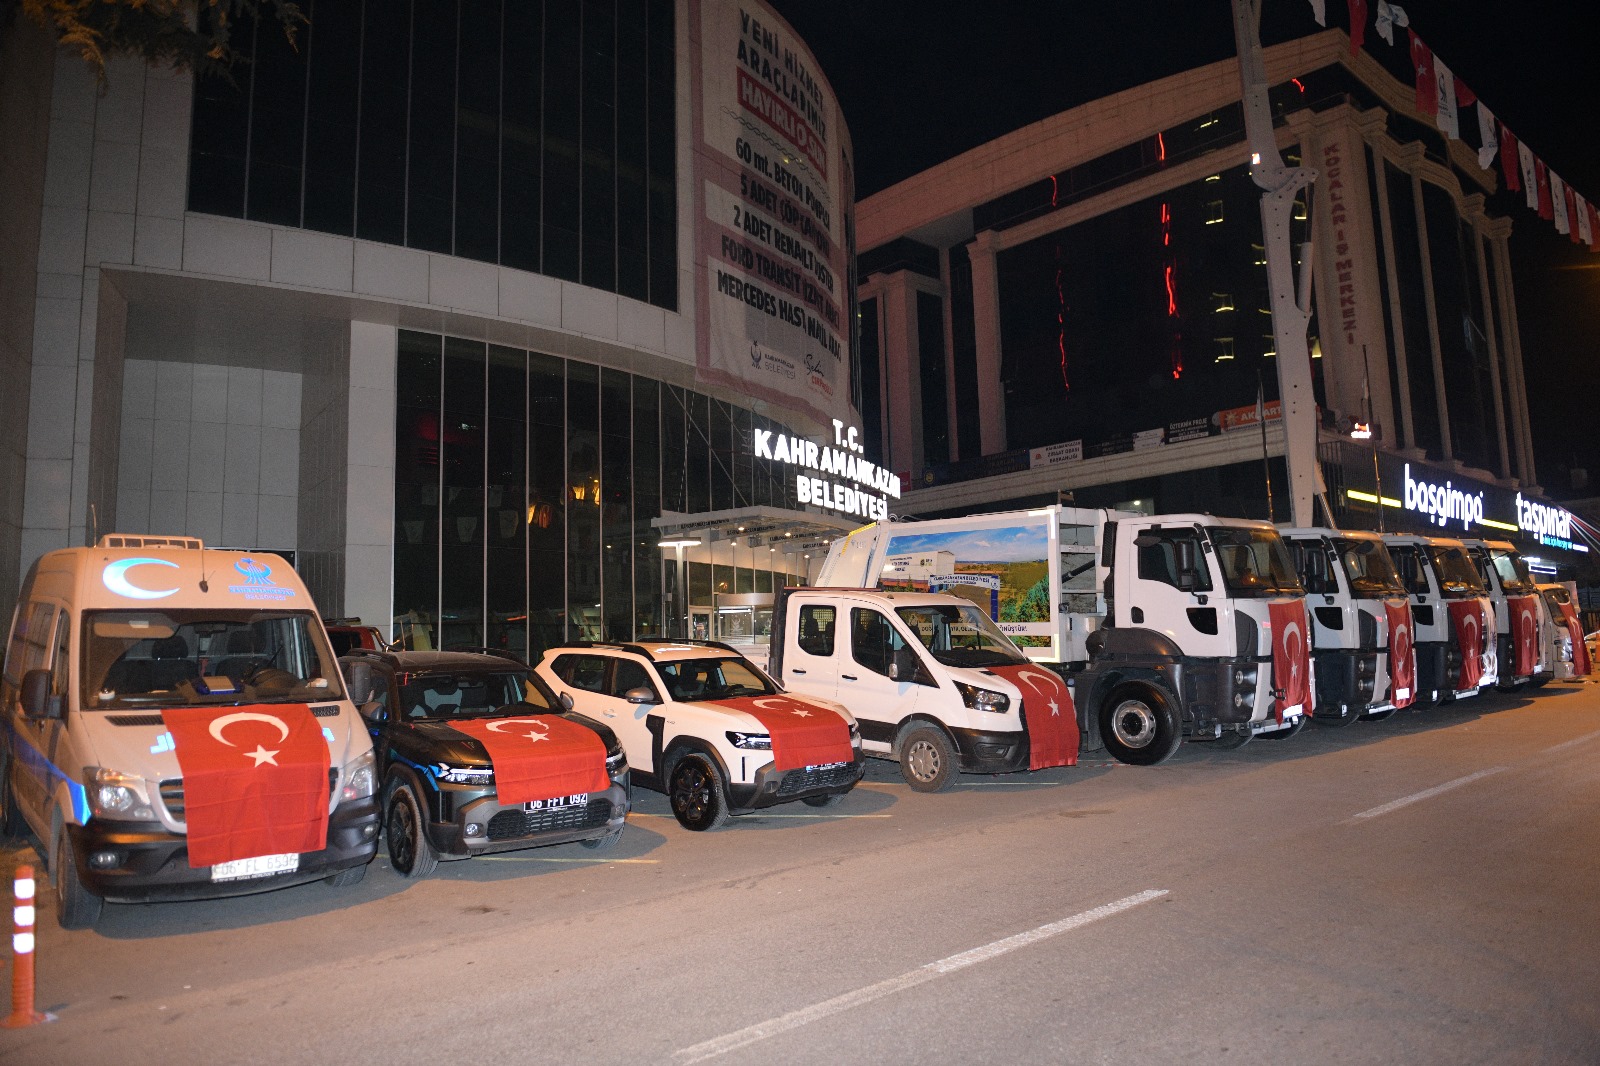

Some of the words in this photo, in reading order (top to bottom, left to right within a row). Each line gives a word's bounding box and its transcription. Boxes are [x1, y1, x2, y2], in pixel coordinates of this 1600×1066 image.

[740, 7, 778, 60] YENİ
[784, 48, 824, 112] HİZMET
[742, 76, 795, 139] HAYIRLI
[796, 123, 826, 176] OSUN
[736, 137, 752, 164] 60
[740, 173, 748, 196] 5
[750, 180, 778, 214] ADET
[734, 204, 742, 228] 2
[744, 210, 772, 244] ADET
[722, 234, 754, 270] FORD
[718, 269, 776, 317] MERCEDES
[832, 418, 864, 454] T.C.
[754, 428, 901, 500] KAHRAMANKAZAN
[796, 474, 888, 521] BELEDİYESİ
[1404, 462, 1484, 531] başgimpa
[530, 800, 543, 810] 06
[221, 862, 237, 876] 06
[246, 860, 258, 872] FL
